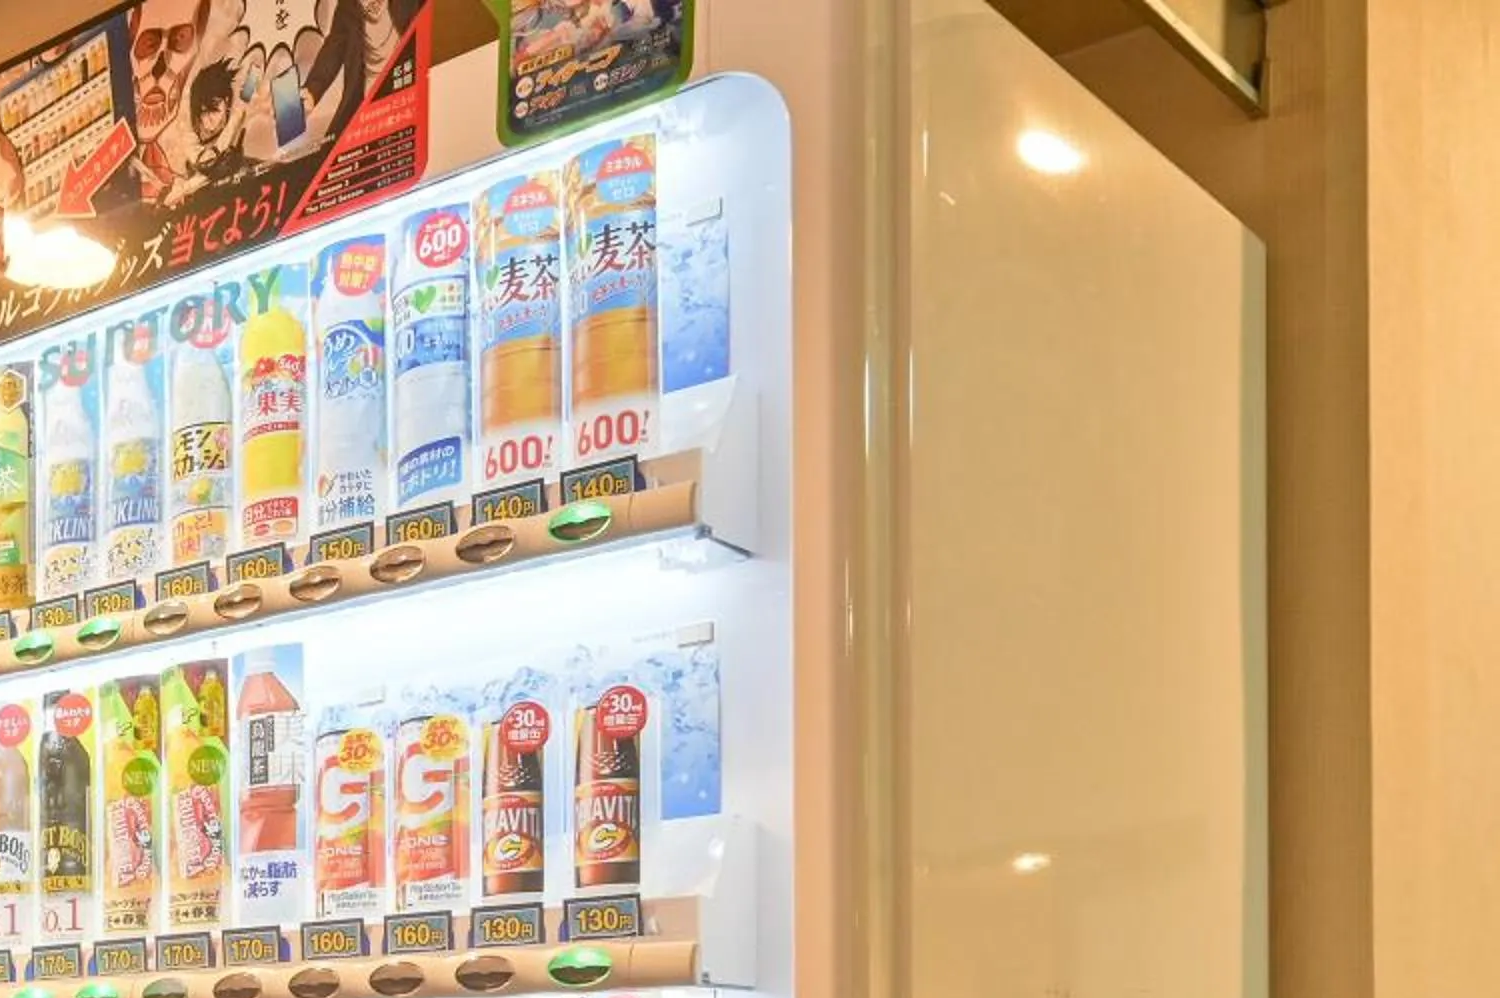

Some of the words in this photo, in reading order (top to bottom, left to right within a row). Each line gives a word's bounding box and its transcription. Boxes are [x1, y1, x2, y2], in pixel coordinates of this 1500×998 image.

[419, 224, 462, 258] 600
[592, 221, 656, 272] 麦茶
[499, 255, 559, 303] 麦茶
[571, 473, 628, 501] 140円
[483, 494, 536, 522] 140円
[395, 519, 446, 542] 160円
[191, 758, 224, 776] NEW
[243, 880, 280, 899] 減らす
[480, 916, 535, 940] 130円
[577, 906, 634, 932] 130円
[310, 931, 356, 953] 160円
[393, 923, 446, 947] 160円
